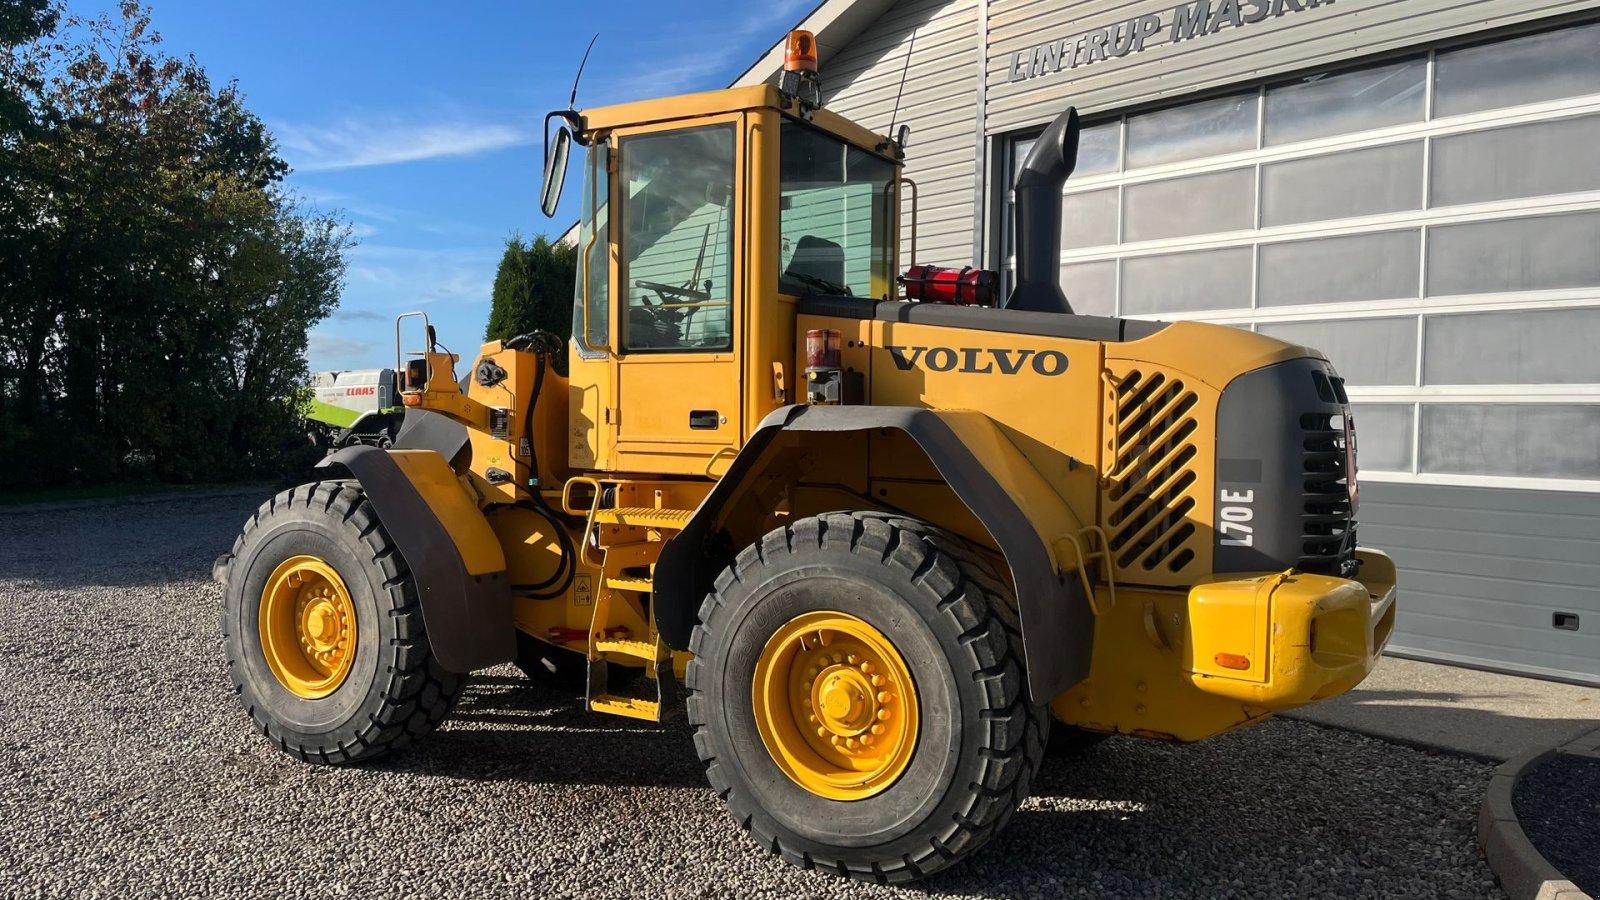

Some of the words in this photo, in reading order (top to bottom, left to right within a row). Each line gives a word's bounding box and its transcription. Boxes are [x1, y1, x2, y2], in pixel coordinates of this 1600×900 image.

[1008, 14, 1161, 83] LINTRUP
[1169, 0, 1335, 43] MAS
[885, 345, 1069, 377] VOLVO
[346, 386, 375, 396] CLAAS
